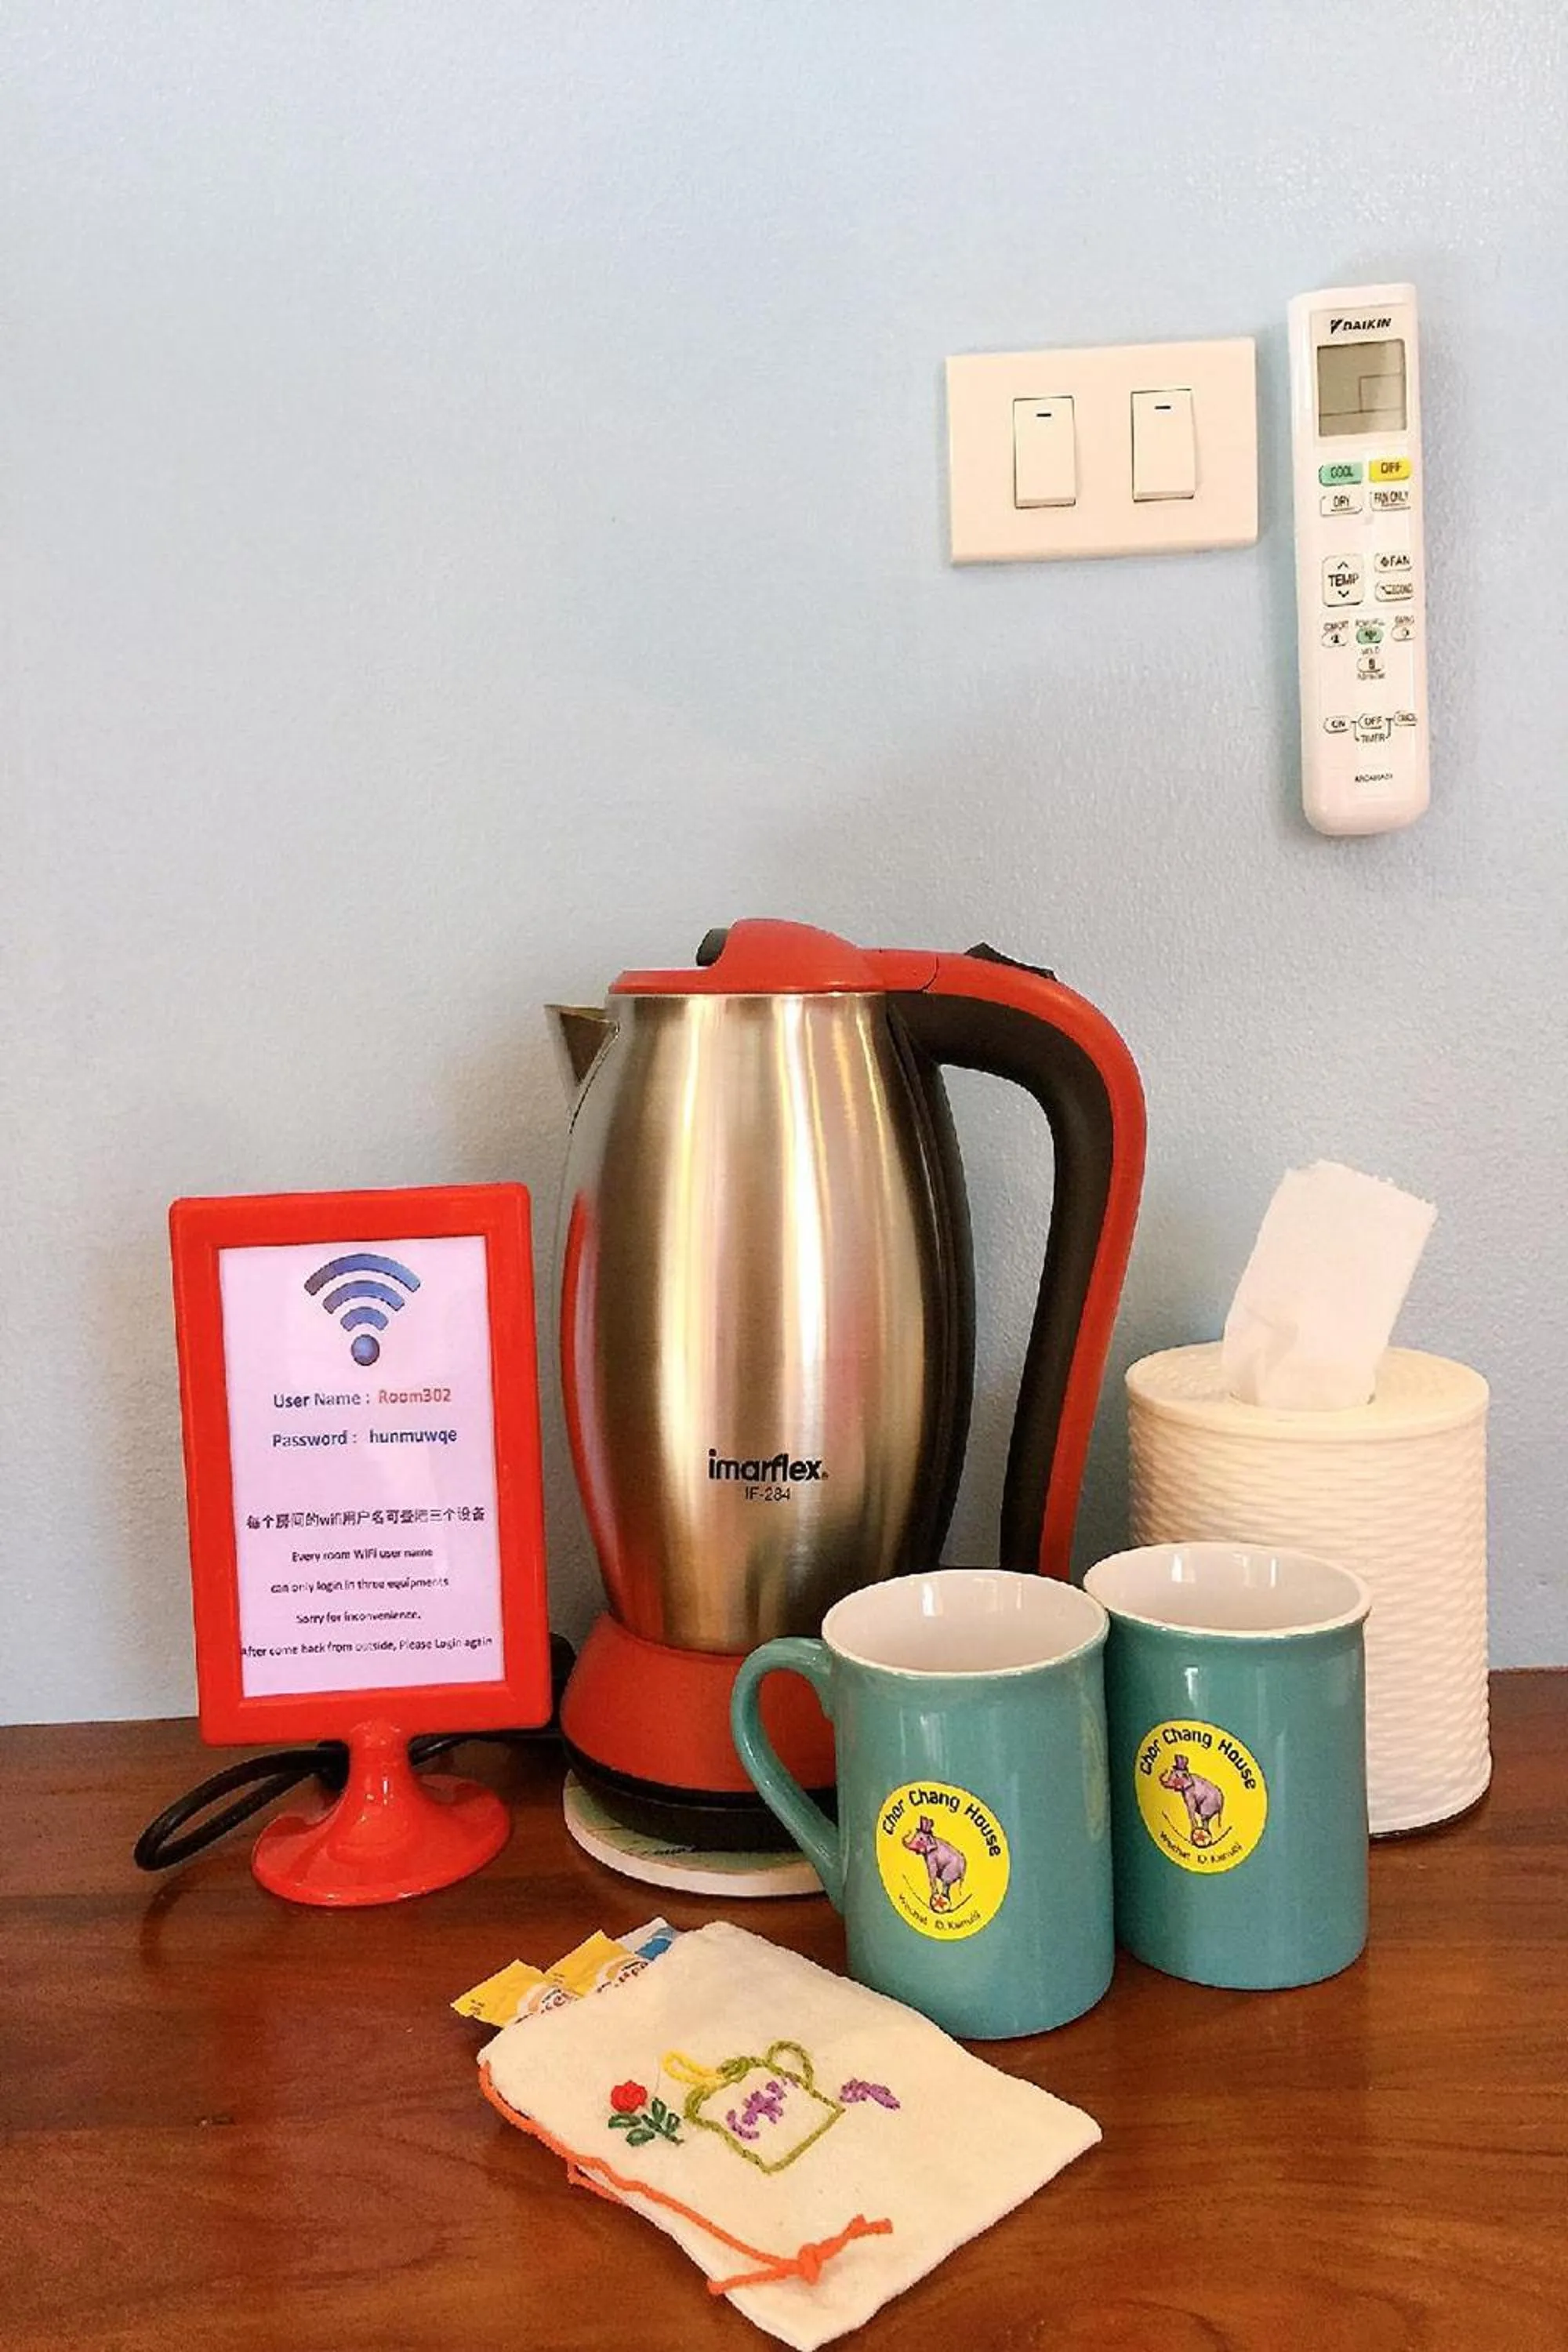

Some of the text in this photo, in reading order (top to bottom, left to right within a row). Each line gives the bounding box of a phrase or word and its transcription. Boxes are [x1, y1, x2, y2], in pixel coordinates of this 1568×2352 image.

[1342, 318, 1392, 331] DAIKIN
[1330, 465, 1354, 478] COOL
[1381, 462, 1402, 474] OFF
[1390, 555, 1410, 566] FAN
[1327, 573, 1359, 587] TEMP
[274, 1393, 310, 1408] User
[379, 1388, 452, 1403] Room302
[369, 1428, 457, 1445] hunmuwqe
[708, 1448, 822, 1482] imarflex
[746, 1486, 791, 1501] IF-284
[292, 1551, 321, 1563] Every
[323, 1551, 350, 1560] room
[379, 1549, 401, 1559] user
[404, 1548, 433, 1557] name
[270, 1577, 449, 1594] can only login in three equipments
[326, 1612, 341, 1623] for
[269, 1646, 298, 1657] come
[301, 1642, 325, 1653] back
[327, 1641, 353, 1653] from
[399, 1639, 432, 1650] Please
[464, 1637, 492, 1650] again
[1140, 1727, 1257, 1790] Chor Chang House
[882, 1788, 1002, 1857] Chor Chang House
